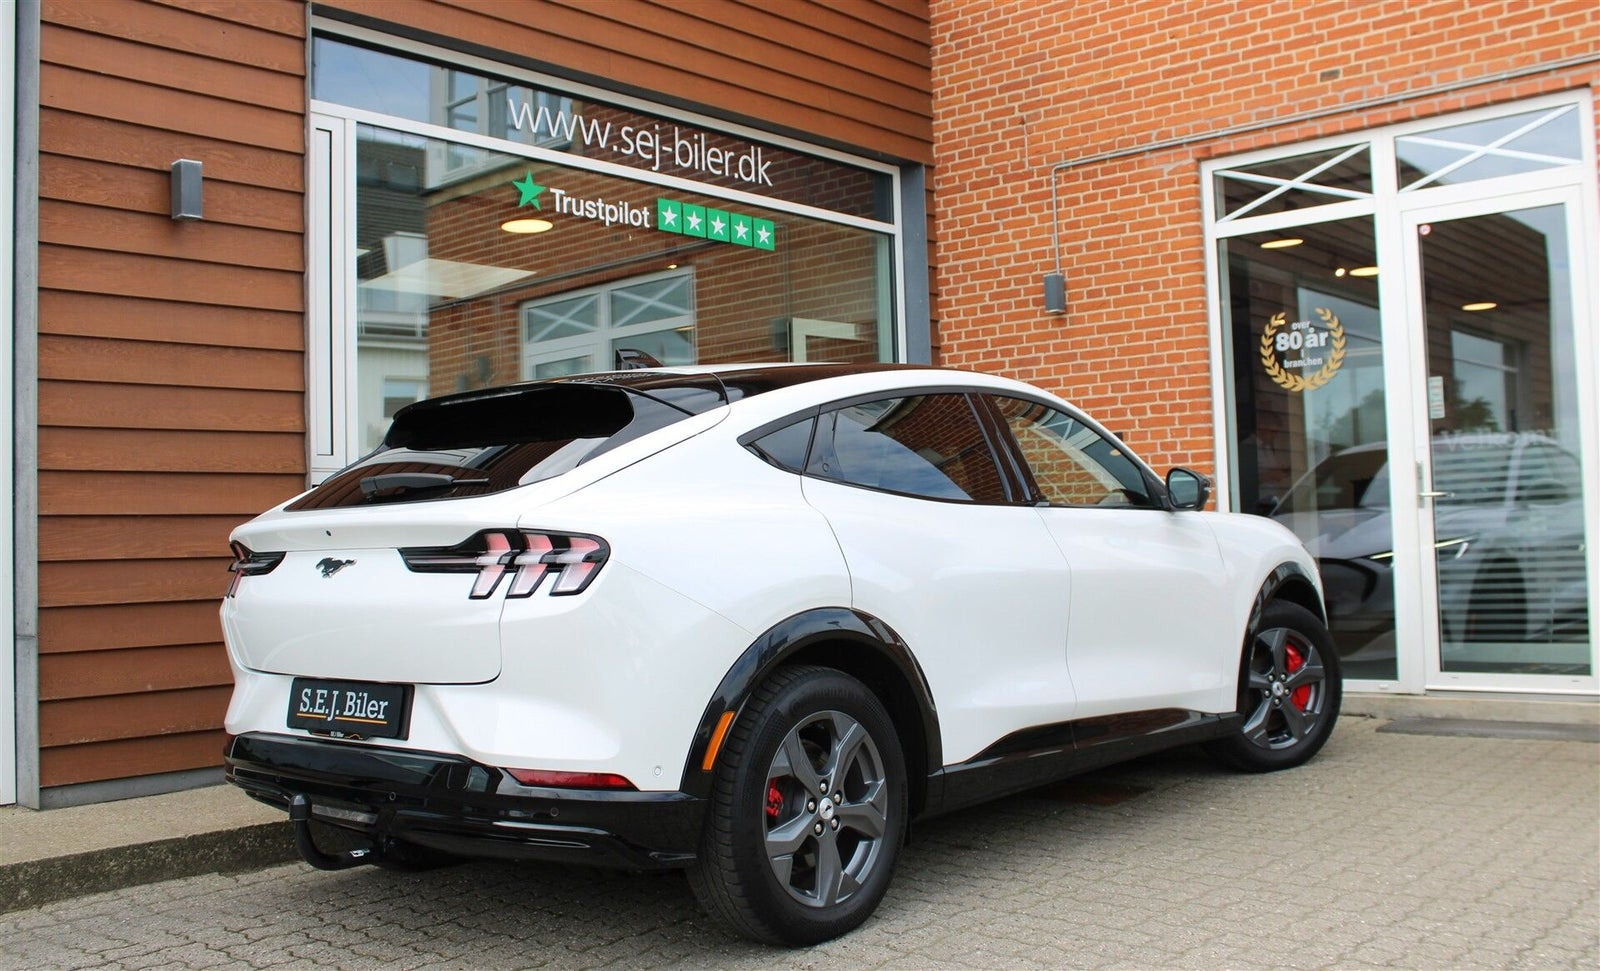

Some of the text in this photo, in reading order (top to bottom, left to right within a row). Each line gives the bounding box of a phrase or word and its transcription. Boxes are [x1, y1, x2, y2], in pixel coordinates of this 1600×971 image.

[508, 98, 774, 187] www.sej-biler.dk
[550, 188, 651, 229] Trustpilot
[1275, 327, 1329, 352] 80 år
[1291, 320, 1311, 331] over
[1283, 357, 1323, 369] branchen
[300, 688, 389, 721] S.E.J. Biler
